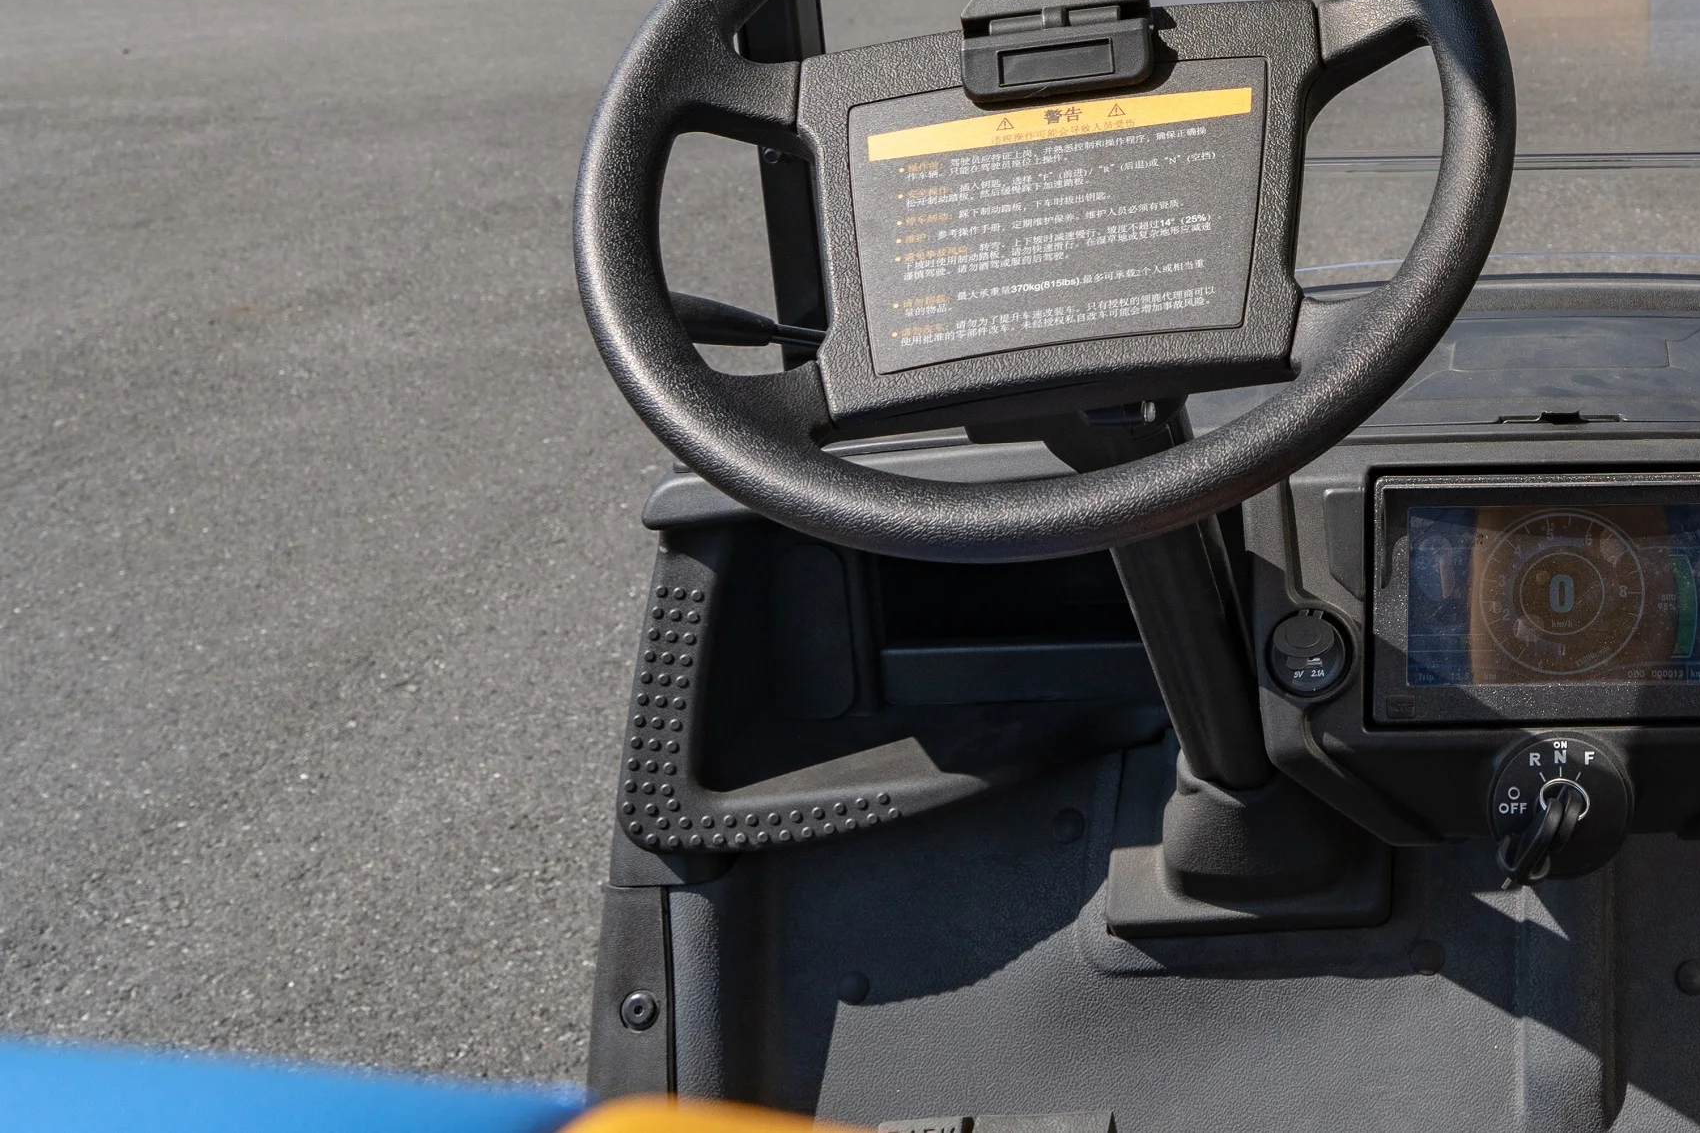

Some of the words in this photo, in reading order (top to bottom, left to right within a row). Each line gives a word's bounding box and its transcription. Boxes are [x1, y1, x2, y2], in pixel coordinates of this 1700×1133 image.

[1044, 106, 1083, 125] 警告
[1546, 529, 1554, 540] 5
[1585, 534, 1593, 546] 6
[1499, 574, 1506, 586] 3
[1549, 574, 1575, 614] 0
[1619, 585, 1628, 597] 8
[1502, 609, 1510, 621] 2
[1293, 670, 1304, 678] 5V
[1553, 740, 1568, 749] ON
[1529, 752, 1541, 766] R
[1554, 749, 1566, 764] N
[1584, 750, 1595, 766] F
[1498, 802, 1527, 814] OFF
